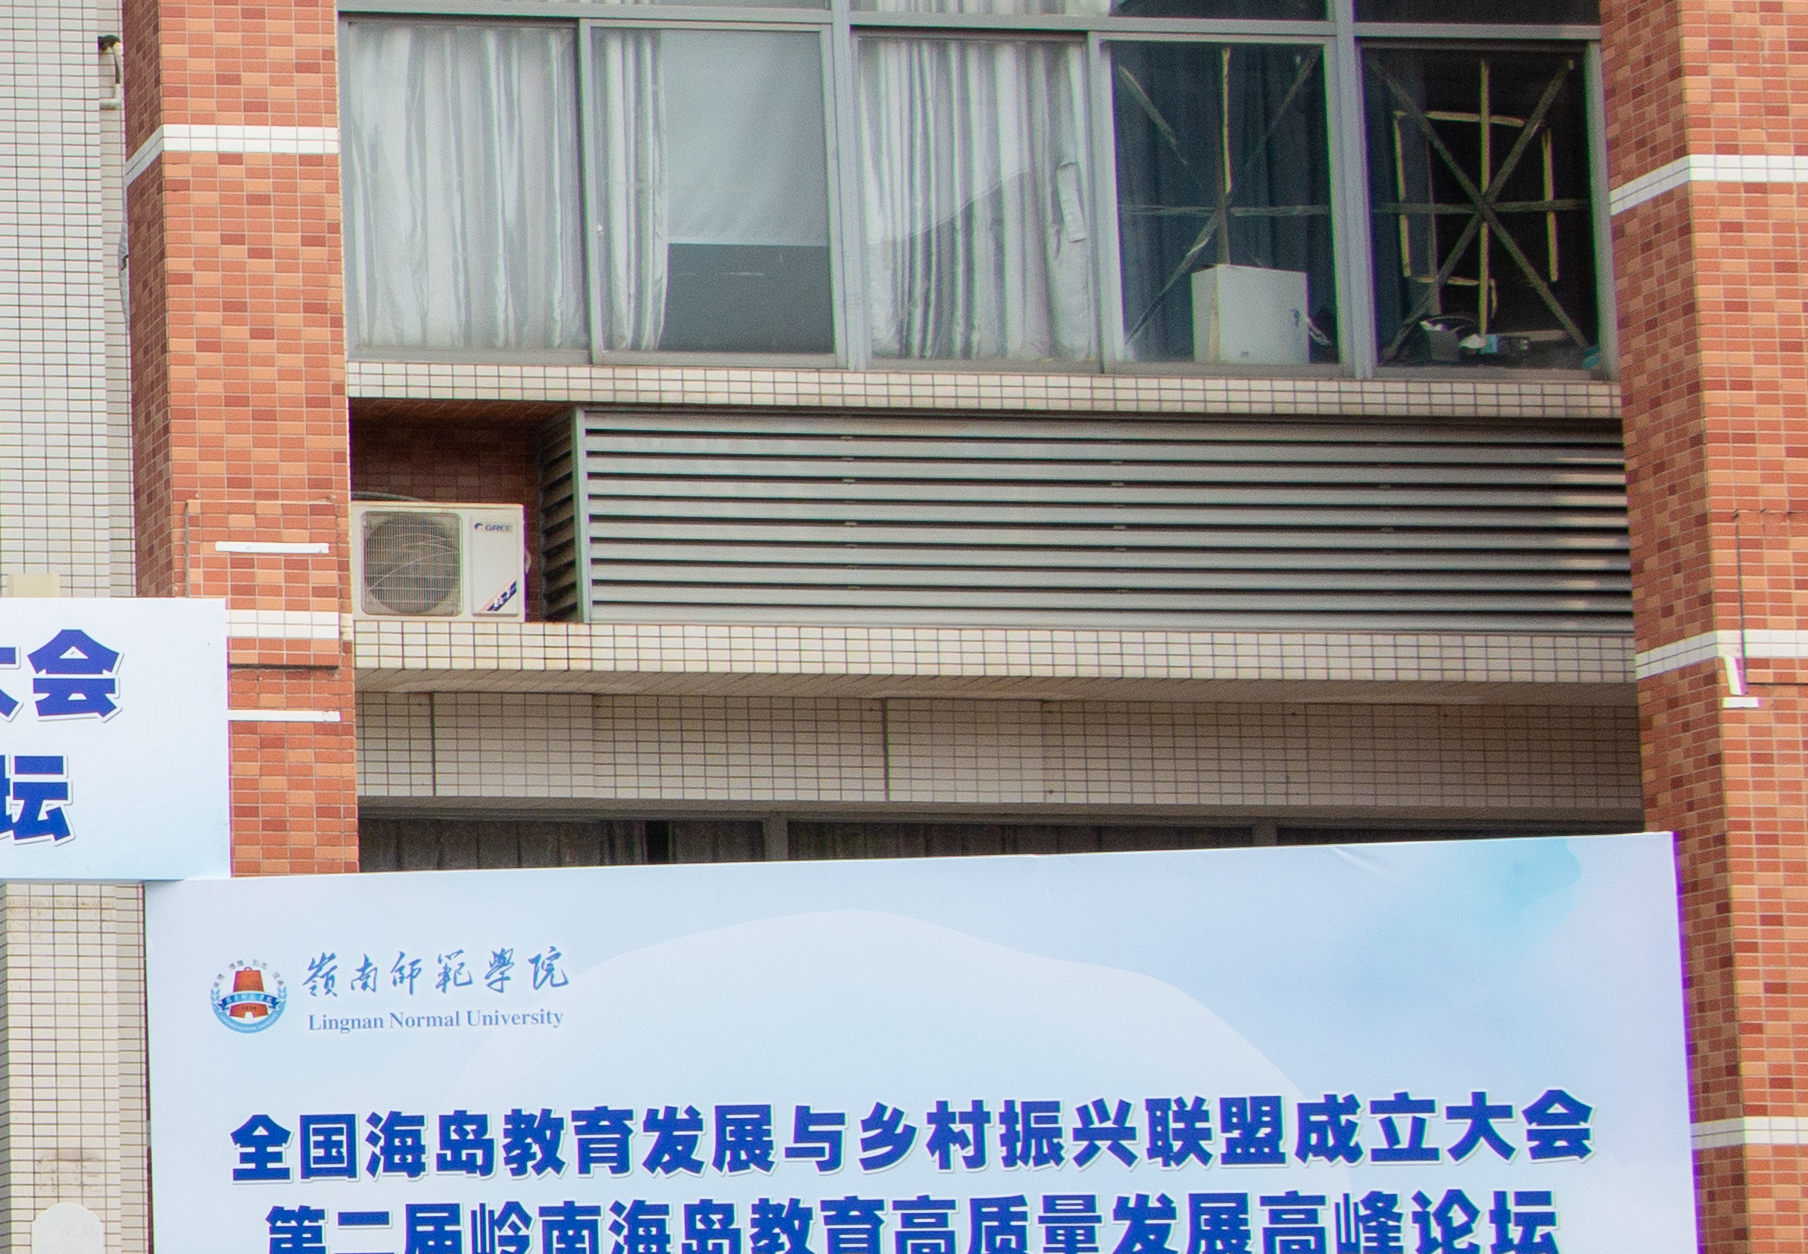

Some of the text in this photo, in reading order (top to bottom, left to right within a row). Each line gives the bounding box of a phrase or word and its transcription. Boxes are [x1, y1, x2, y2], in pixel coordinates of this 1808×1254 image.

[308, 1009, 564, 1033] Lingnan Normal University
[230, 1089, 1593, 1181] 全国海岛教育发展与乡村振兴联盟成立大会
